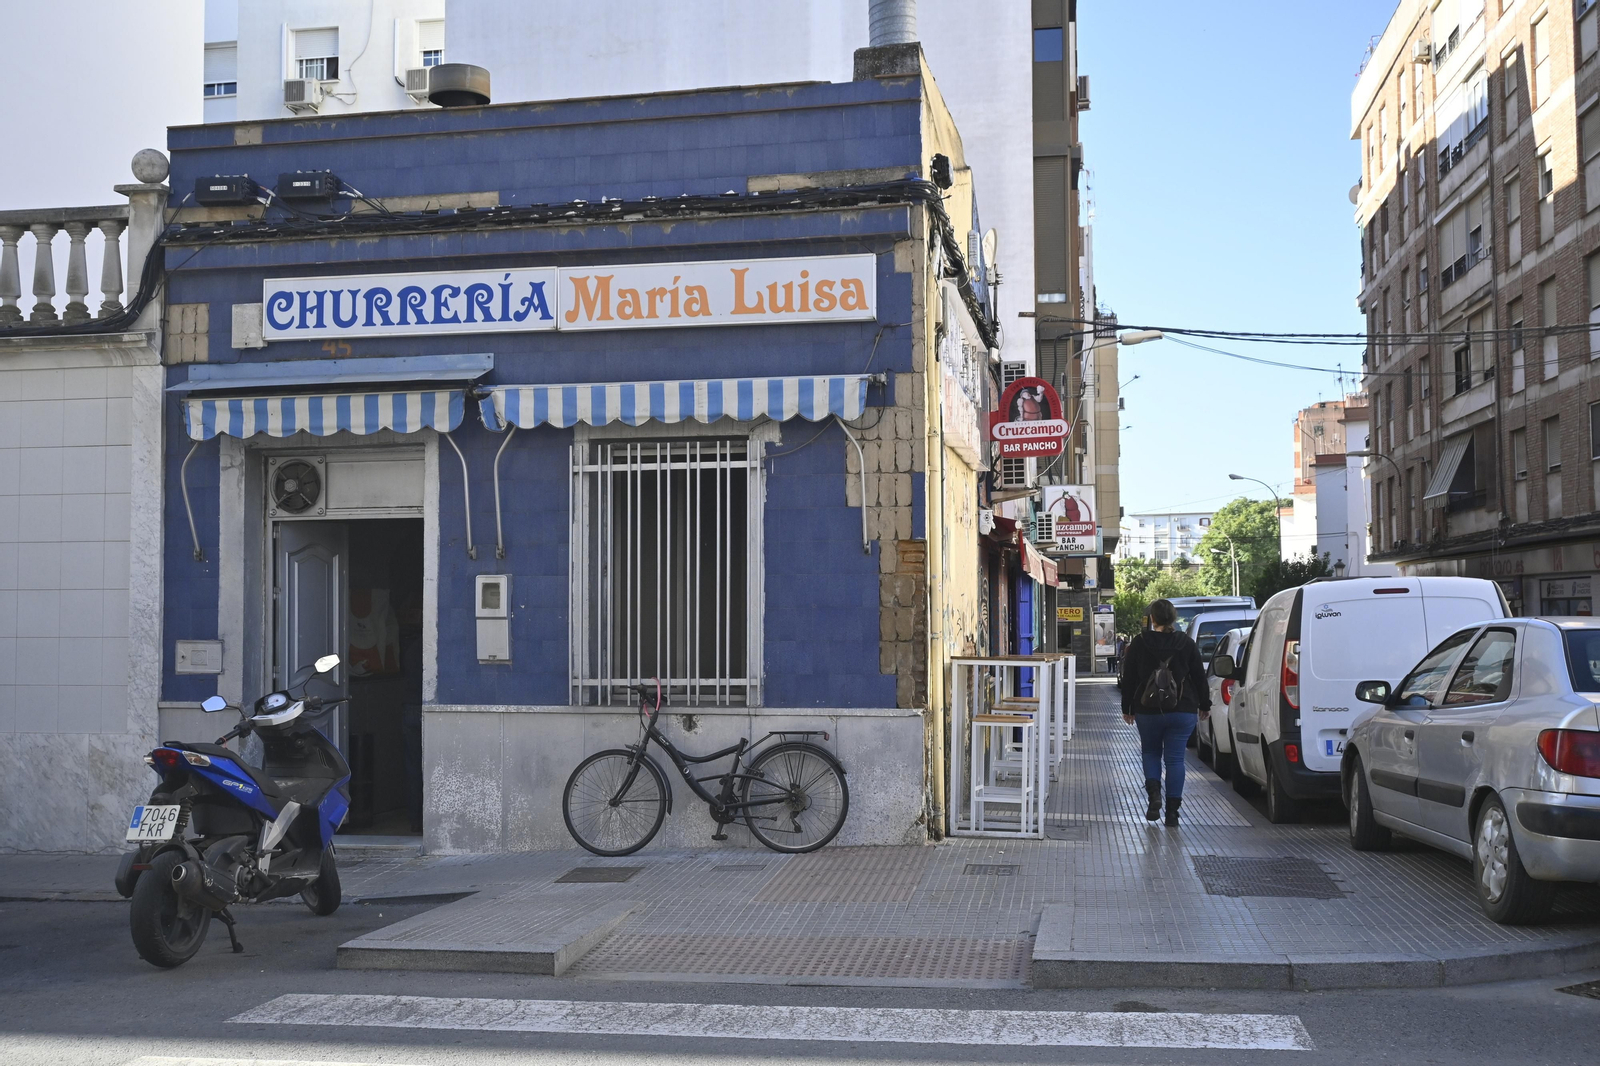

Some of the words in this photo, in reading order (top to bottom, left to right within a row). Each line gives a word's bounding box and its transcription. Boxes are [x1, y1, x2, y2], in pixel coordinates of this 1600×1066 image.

[267, 274, 553, 331] CHURRERÍA
[565, 275, 711, 323] María
[731, 268, 868, 316] Luisa
[998, 424, 1063, 437] Cruzcampo
[1003, 443, 1021, 453] BAR
[1023, 441, 1057, 451] PANCHO
[1056, 523, 1092, 533] uzcampo
[141, 808, 177, 823] 7046
[138, 823, 164, 837] FKR
